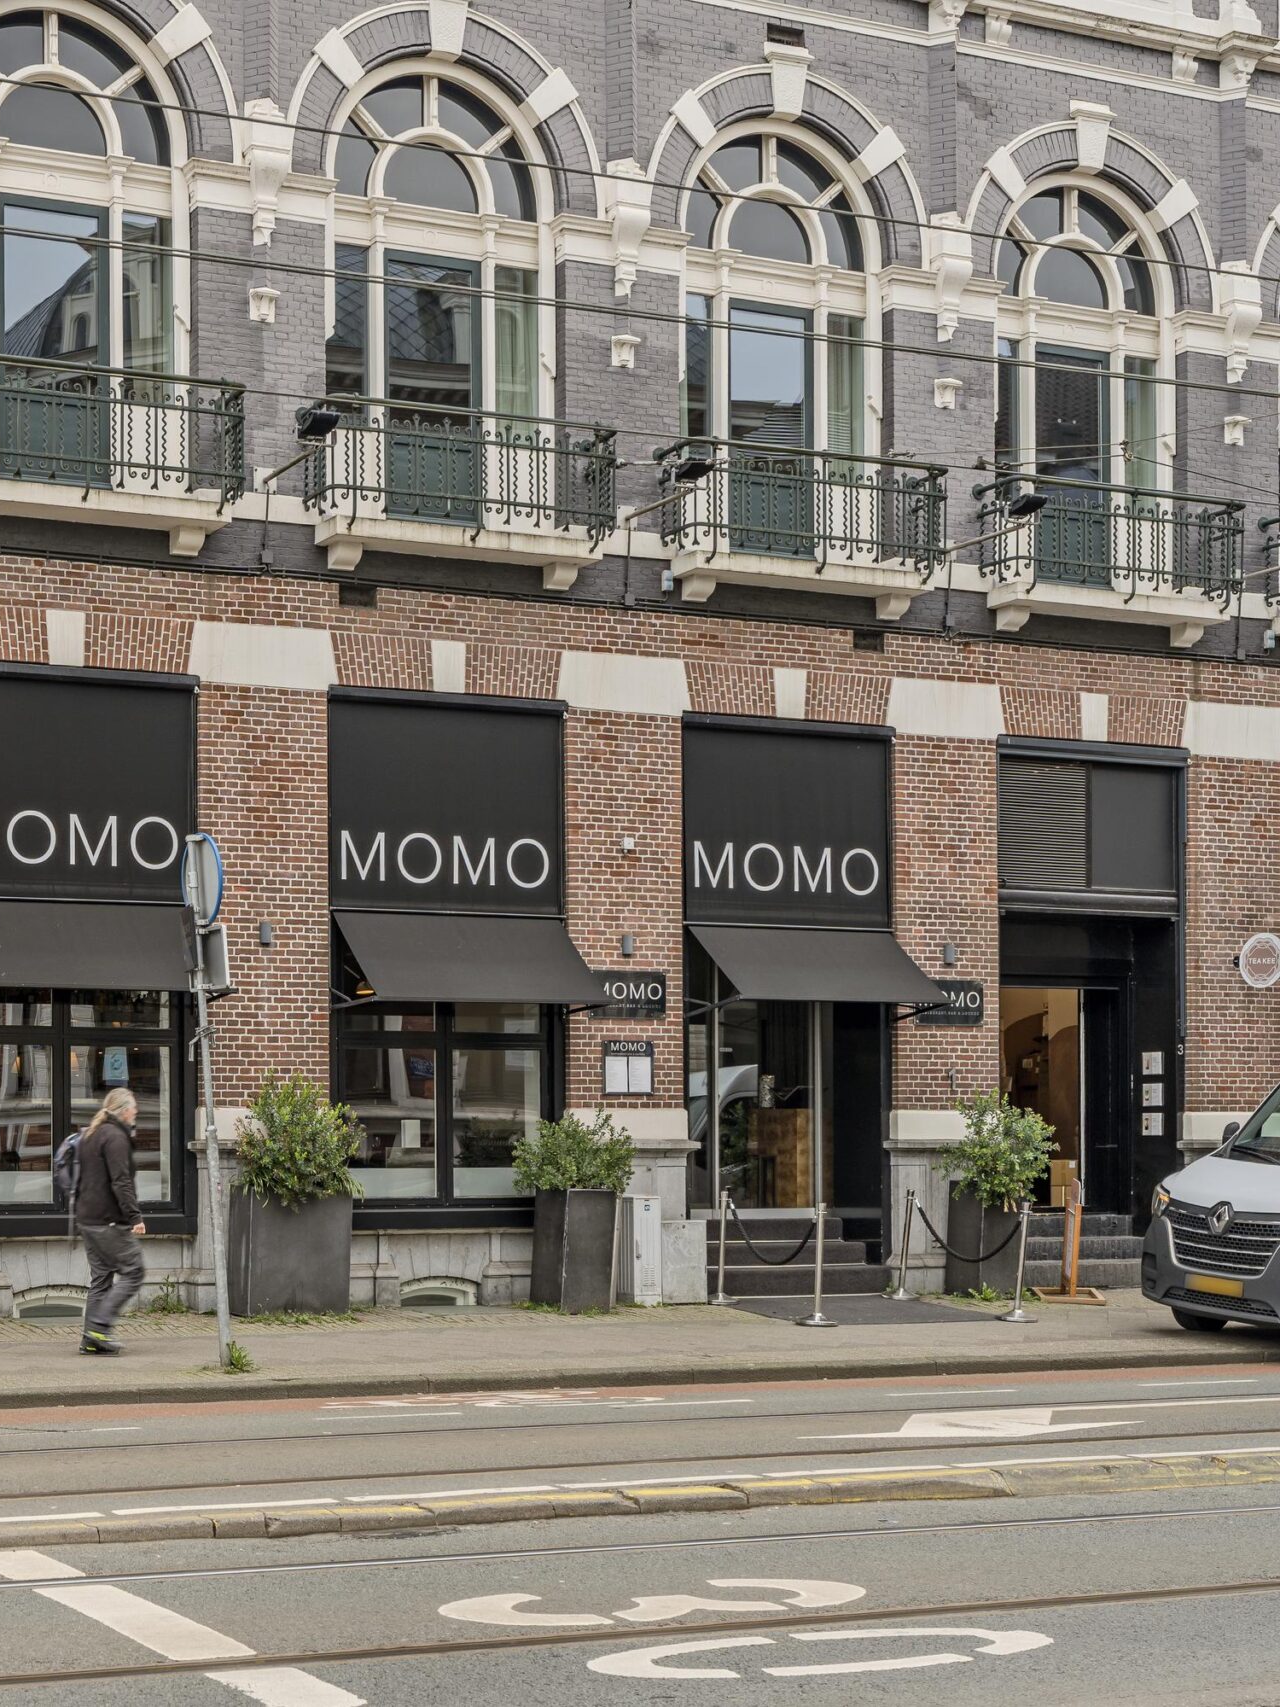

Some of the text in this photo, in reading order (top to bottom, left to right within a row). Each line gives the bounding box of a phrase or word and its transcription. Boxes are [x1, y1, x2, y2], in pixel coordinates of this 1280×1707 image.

[340, 830, 550, 889] MOMO
[693, 840, 879, 896] MOMO
[610, 1041, 646, 1052] MOMO
[1177, 1044, 1184, 1055] 3
